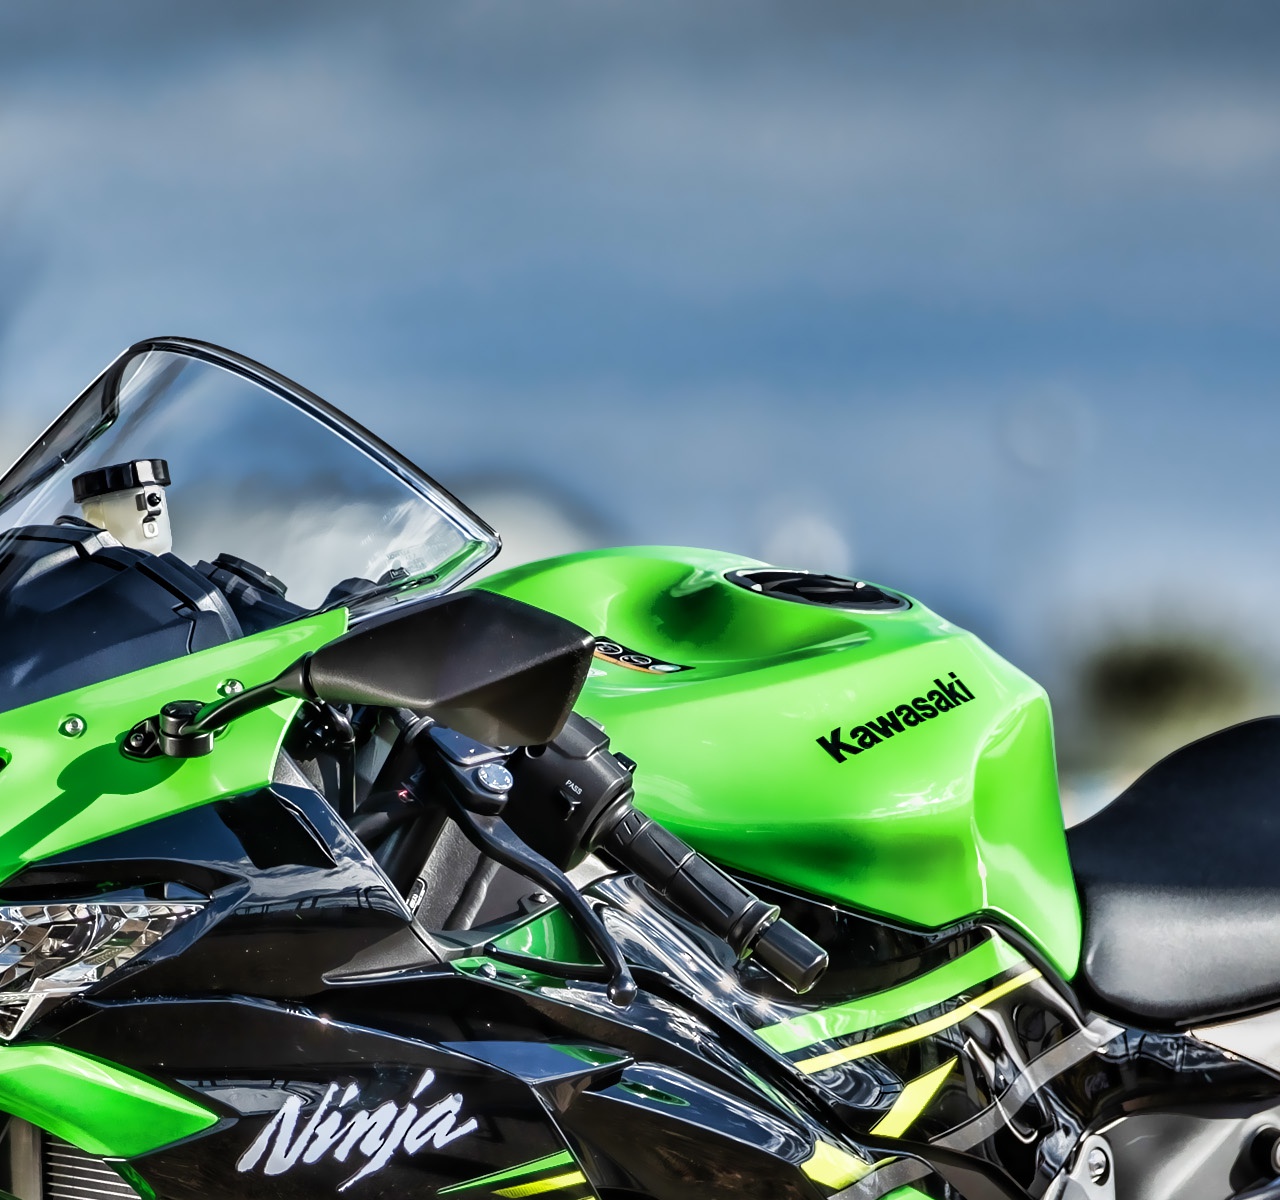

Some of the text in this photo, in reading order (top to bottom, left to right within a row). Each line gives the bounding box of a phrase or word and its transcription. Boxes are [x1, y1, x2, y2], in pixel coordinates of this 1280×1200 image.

[815, 671, 976, 764] Kawasaki
[564, 779, 583, 796] PASS
[235, 1068, 479, 1192] Ninja
